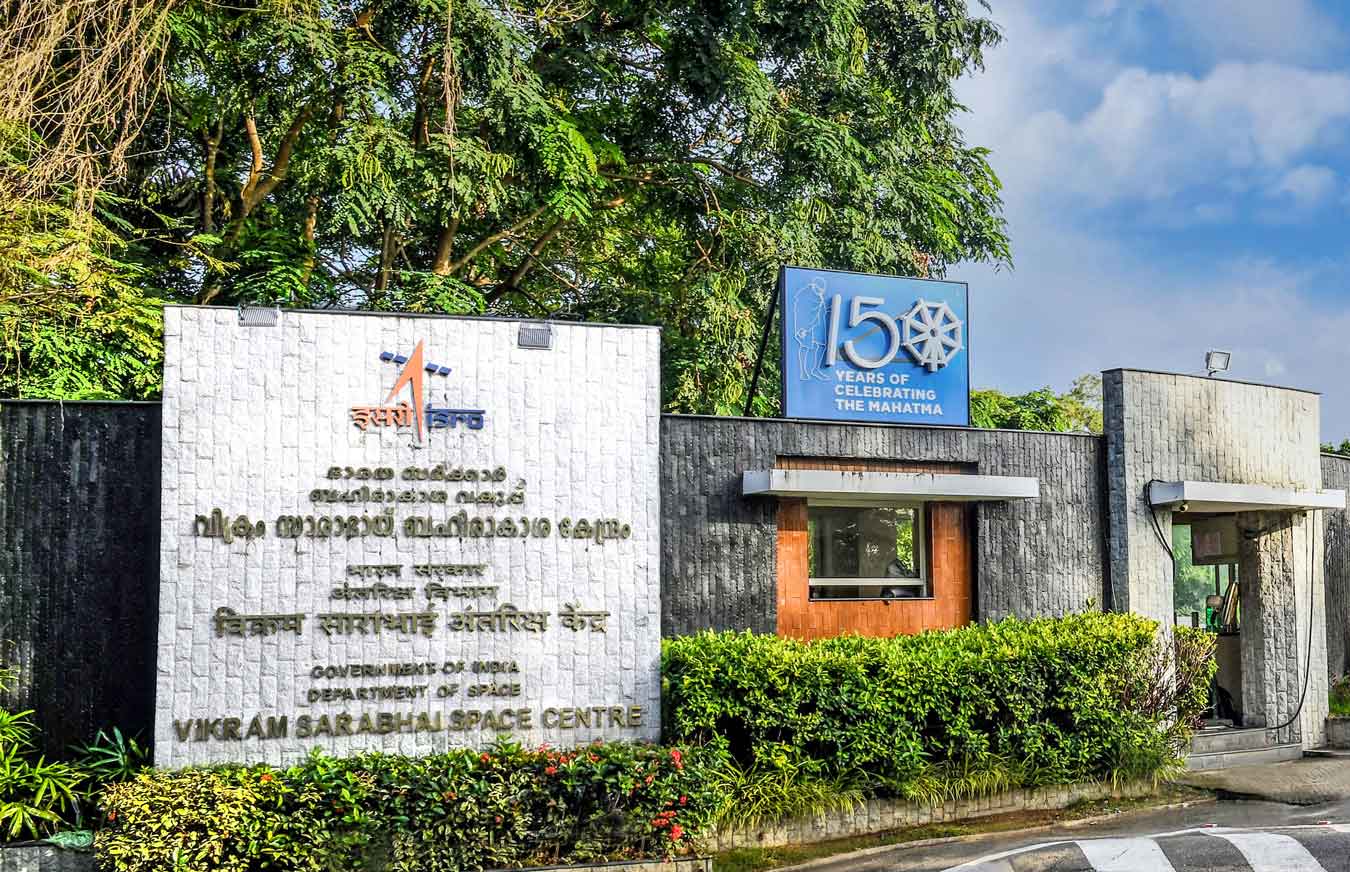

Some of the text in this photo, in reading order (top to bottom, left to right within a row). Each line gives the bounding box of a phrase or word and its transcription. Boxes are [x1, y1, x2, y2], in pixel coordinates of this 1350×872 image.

[836, 370, 910, 385] YEARS OF
[835, 384, 937, 401] CELEBRATING
[351, 400, 413, 431] इसरो
[835, 399, 944, 416] THE MAHATMA
[403, 508, 552, 539] ബഹിരാകാശ
[413, 564, 488, 581] सरकार
[213, 600, 611, 639] विक्रम साराभाई अंतरिक्ष केंद्र
[310, 660, 520, 680] GOVERNMENT OF INDIA
[307, 682, 522, 703] DEPARTMENT OF SPACE
[174, 703, 645, 743] VIKRAM SARABHAI SPACE CENTRE
